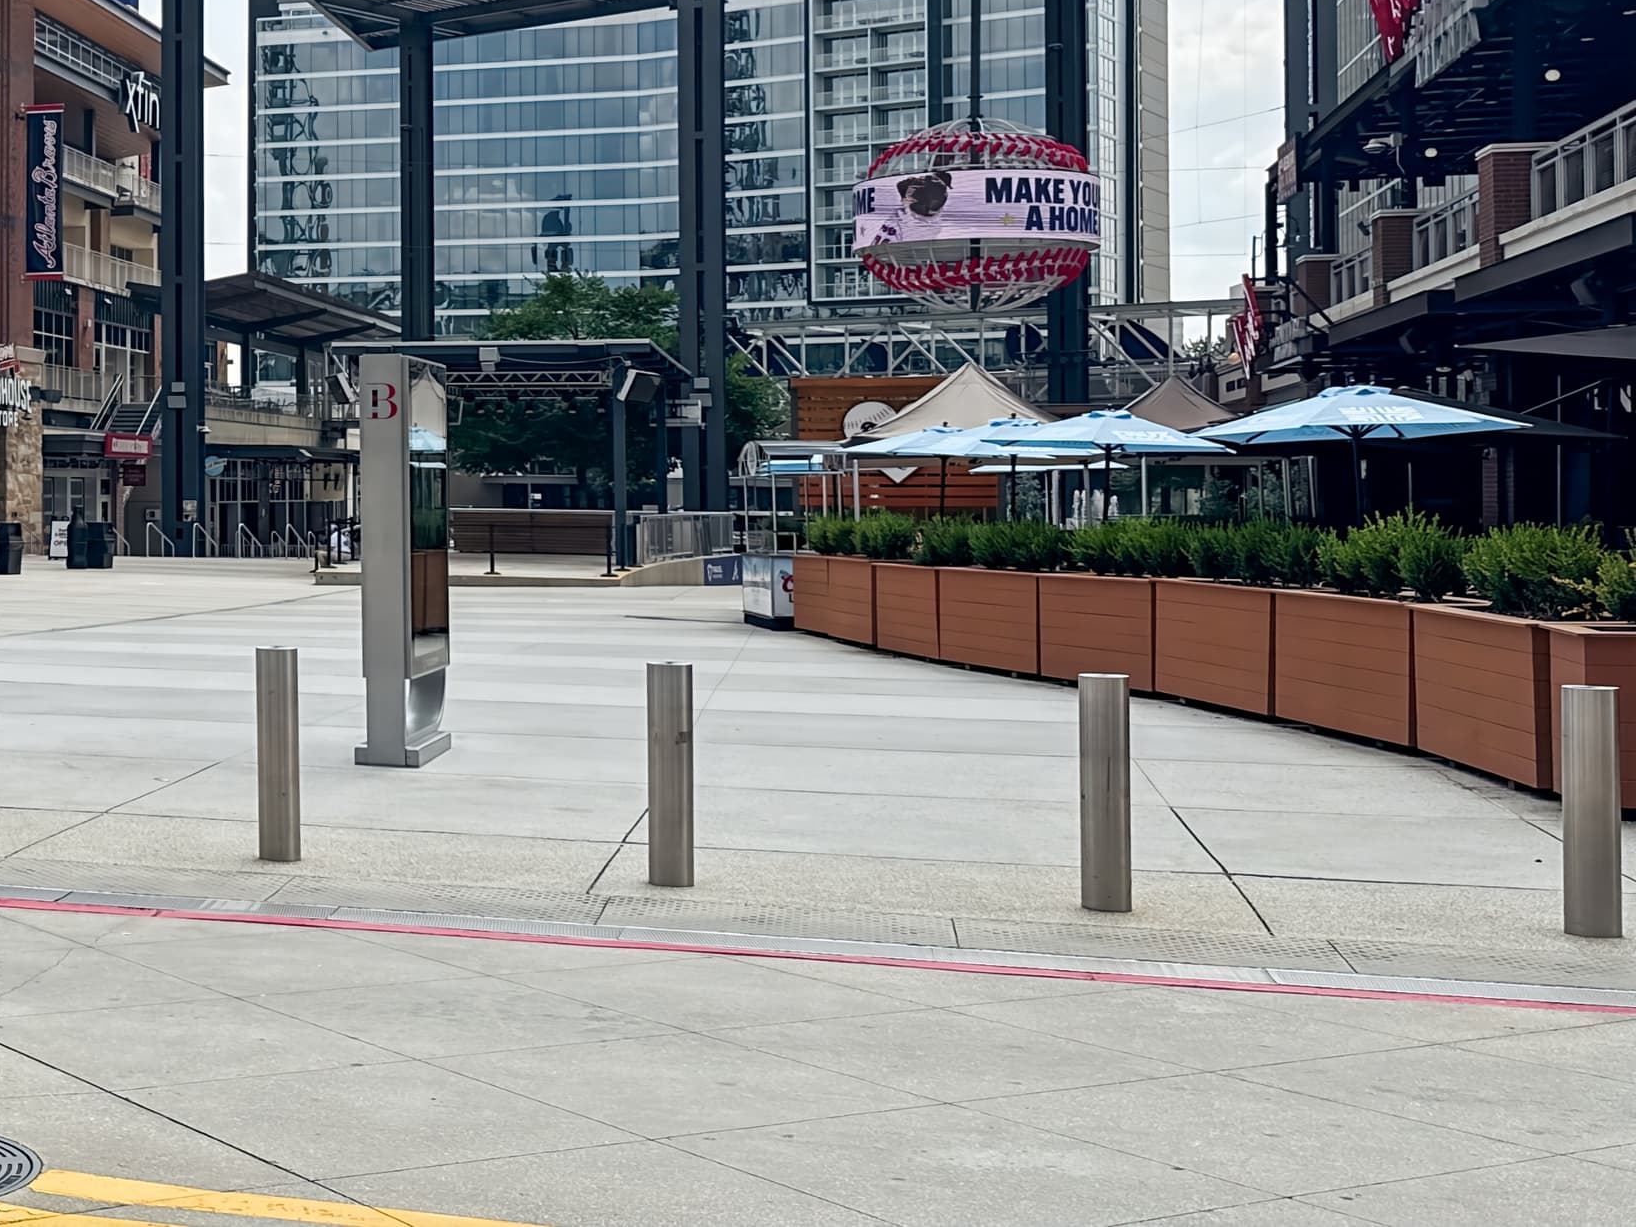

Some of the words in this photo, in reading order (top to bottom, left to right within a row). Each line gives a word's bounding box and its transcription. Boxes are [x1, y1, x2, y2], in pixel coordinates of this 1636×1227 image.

[31, 119, 58, 189] Braves
[985, 177, 1066, 205] MAKE
[1069, 179, 1101, 210] YOU
[32, 186, 57, 269] Atlanta
[1025, 205, 1045, 231] A
[1049, 206, 1099, 235] HOME
[365, 382, 398, 420] B
